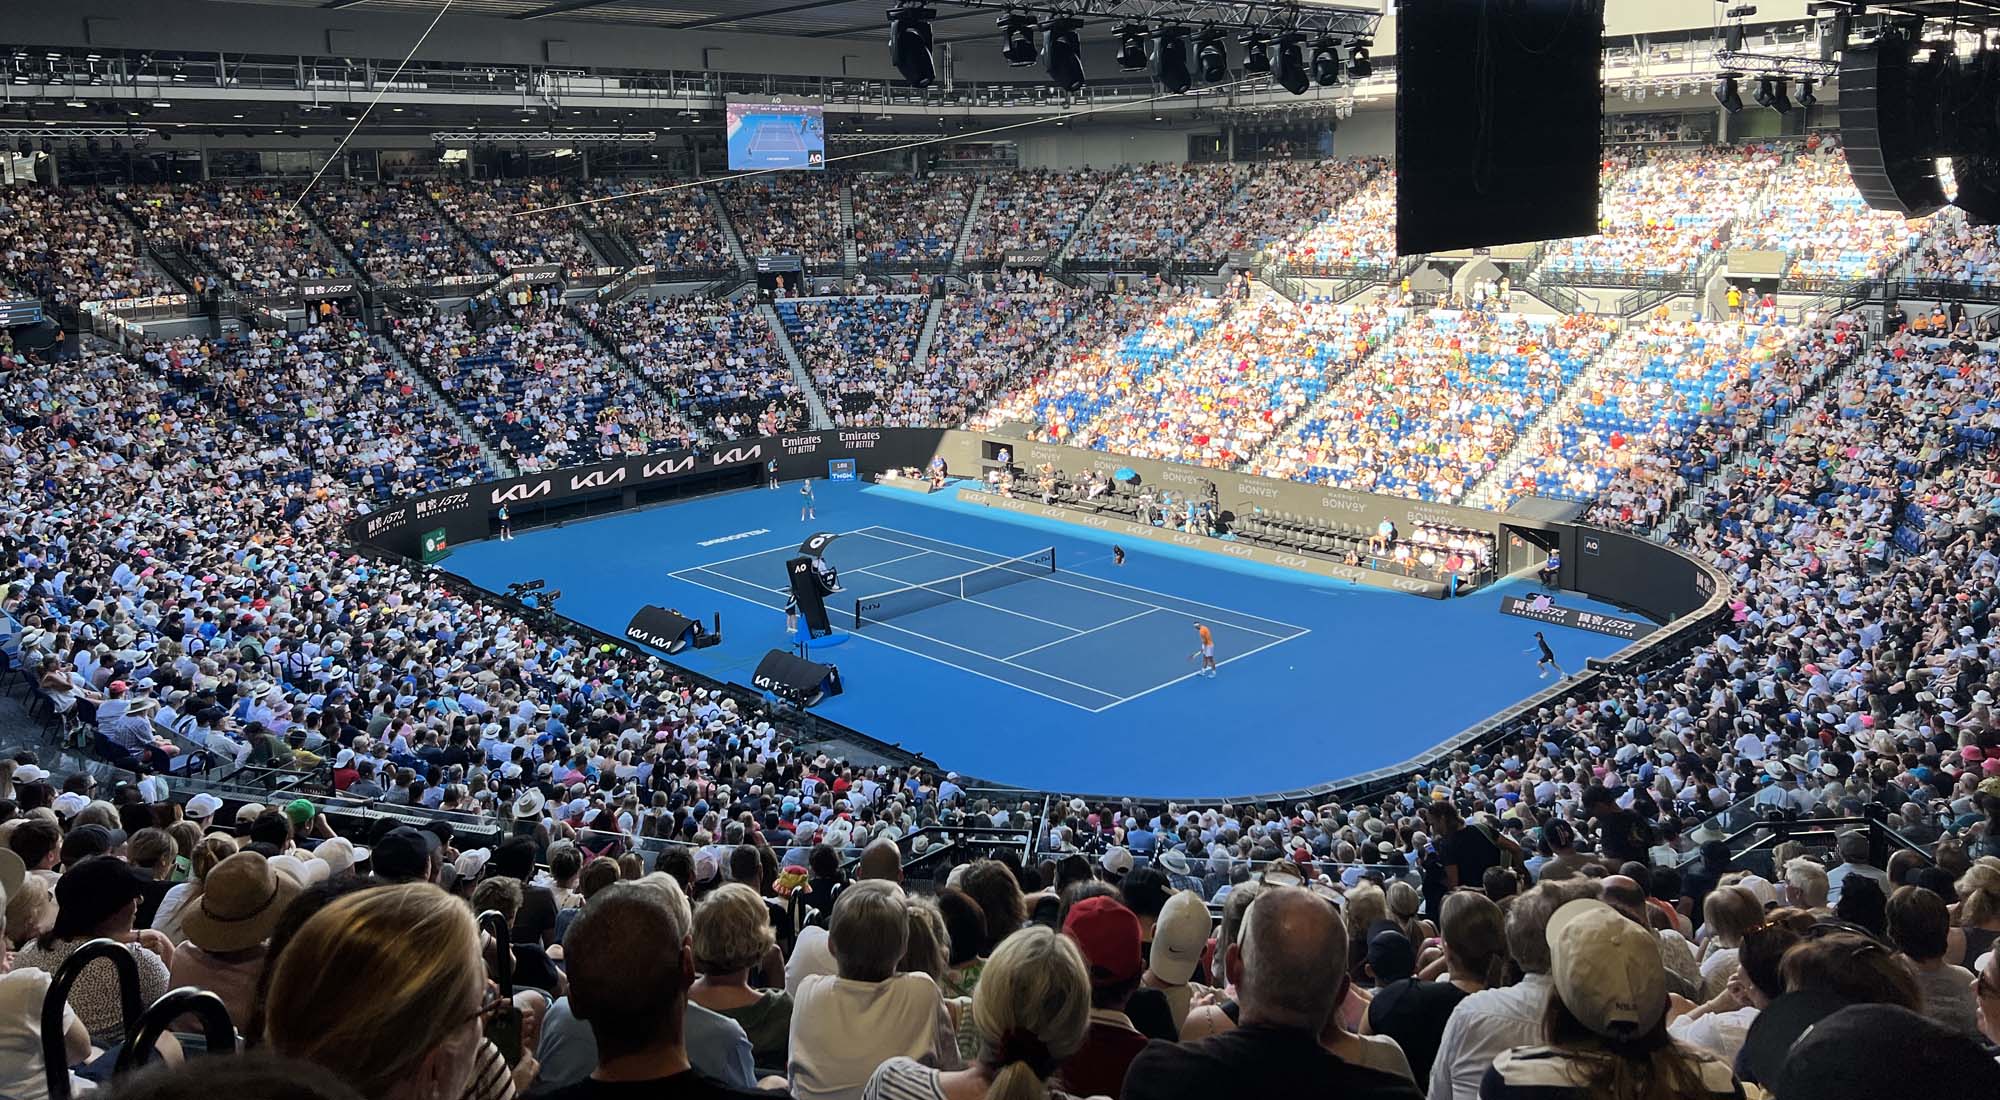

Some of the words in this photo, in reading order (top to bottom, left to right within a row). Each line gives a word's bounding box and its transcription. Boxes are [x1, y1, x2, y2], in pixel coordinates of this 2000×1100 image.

[809, 154, 821, 163] AO
[782, 435, 821, 448] Emirates
[840, 431, 880, 441] Emirates
[788, 446, 796, 455] FLY
[798, 444, 816, 454] BETTER
[846, 441, 854, 449] FLY
[856, 440, 874, 448] BETTER
[492, 479, 551, 504] KIA
[571, 467, 626, 491] KIA
[643, 455, 694, 478] KIA
[714, 444, 761, 466] KIA
[1239, 483, 1278, 499] BONVOY
[1322, 497, 1366, 513] BONVOY
[1586, 541, 1598, 550] AO
[795, 563, 806, 573] AO
[628, 627, 649, 642] KIA
[650, 635, 672, 650] KIA
